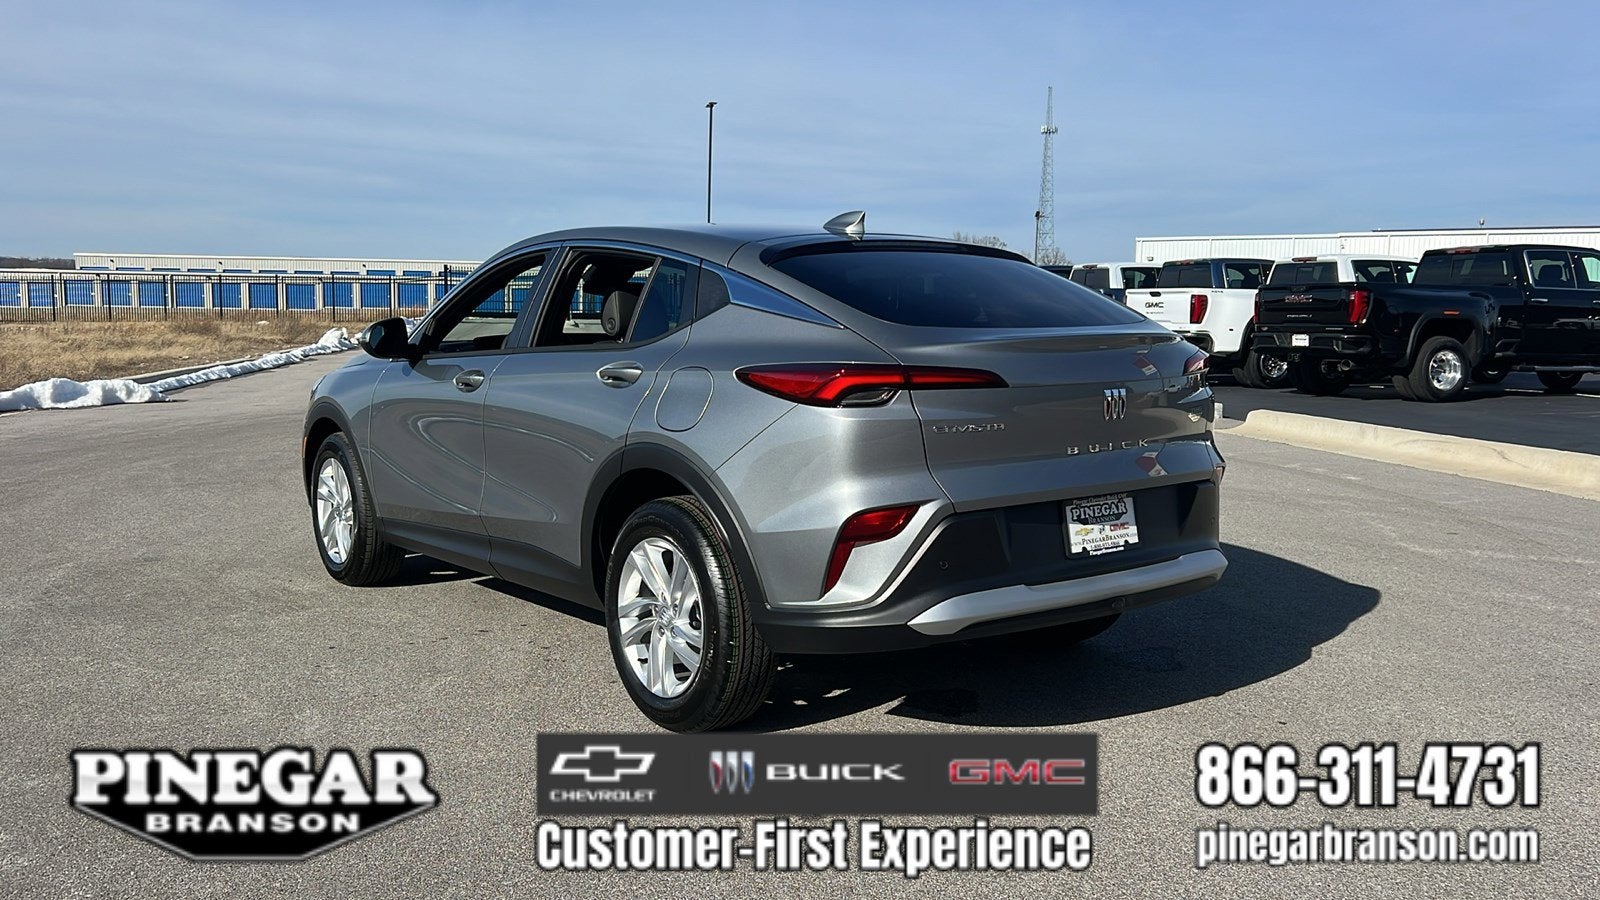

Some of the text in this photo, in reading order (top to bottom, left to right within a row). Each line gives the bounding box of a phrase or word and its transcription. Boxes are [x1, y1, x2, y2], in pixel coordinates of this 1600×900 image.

[1066, 439, 1149, 455] BUICK
[1072, 503, 1127, 520] PINEGAR
[1088, 515, 1116, 525] BRANSON
[1110, 522, 1129, 531] GMC
